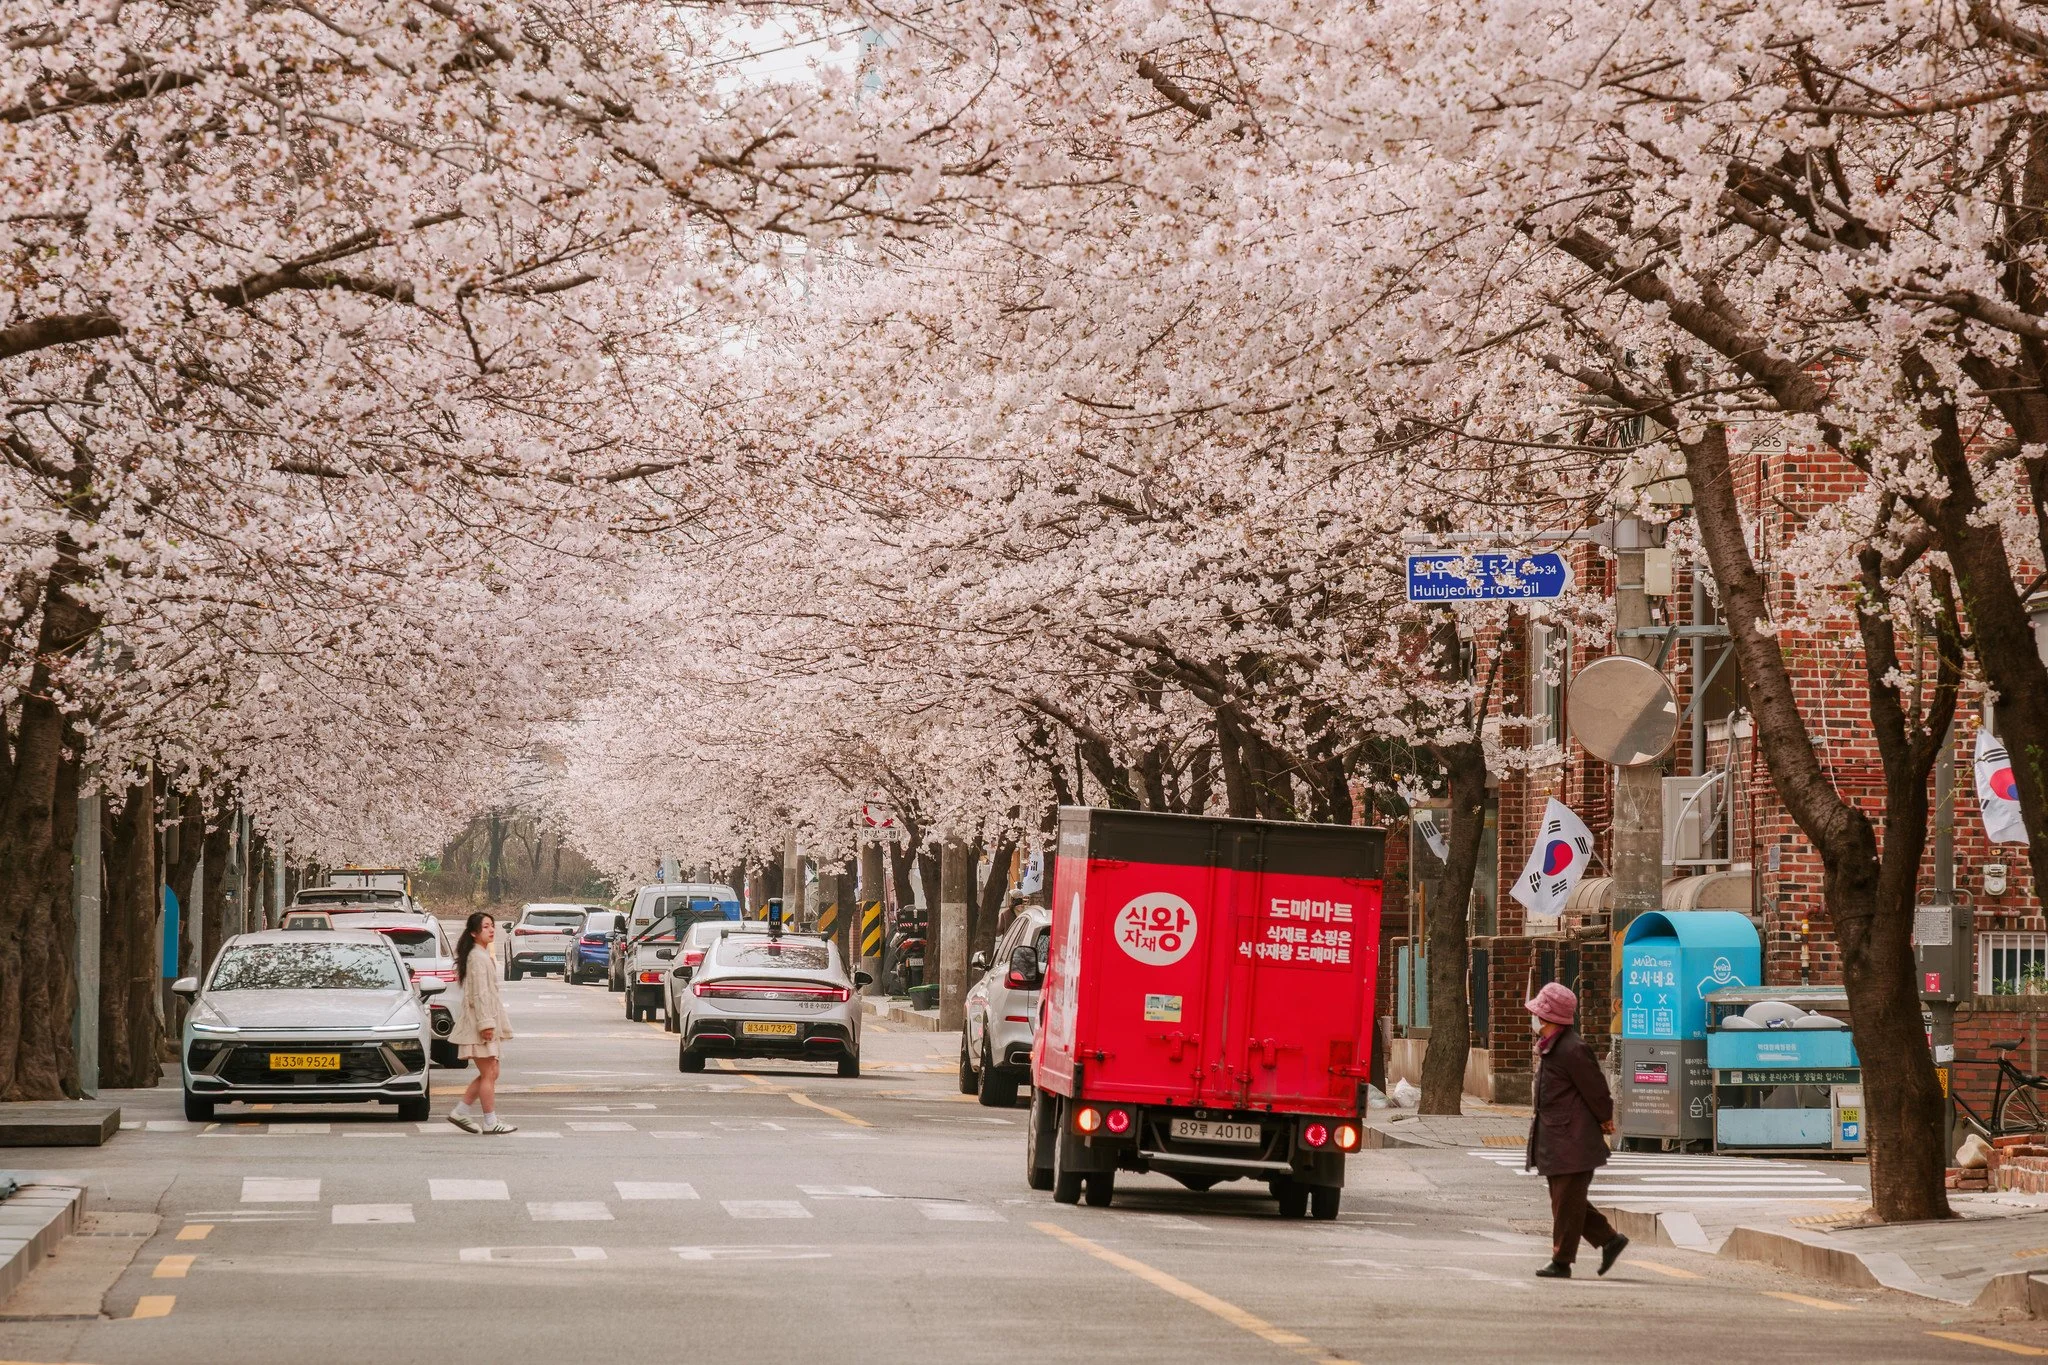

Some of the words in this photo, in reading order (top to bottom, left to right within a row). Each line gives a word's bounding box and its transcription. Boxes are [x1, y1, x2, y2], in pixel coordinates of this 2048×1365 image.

[1413, 584, 1505, 598] Huiujeong-ro
[1269, 897, 1353, 923] 도매마트
[1266, 925, 1308, 943] 식재료
[1310, 929, 1352, 947] 쇼핑은
[1295, 945, 1351, 964] 도매마트
[771, 1024, 792, 1033] 7322
[306, 1056, 335, 1067] 9524
[1215, 1124, 1253, 1139] 4010
